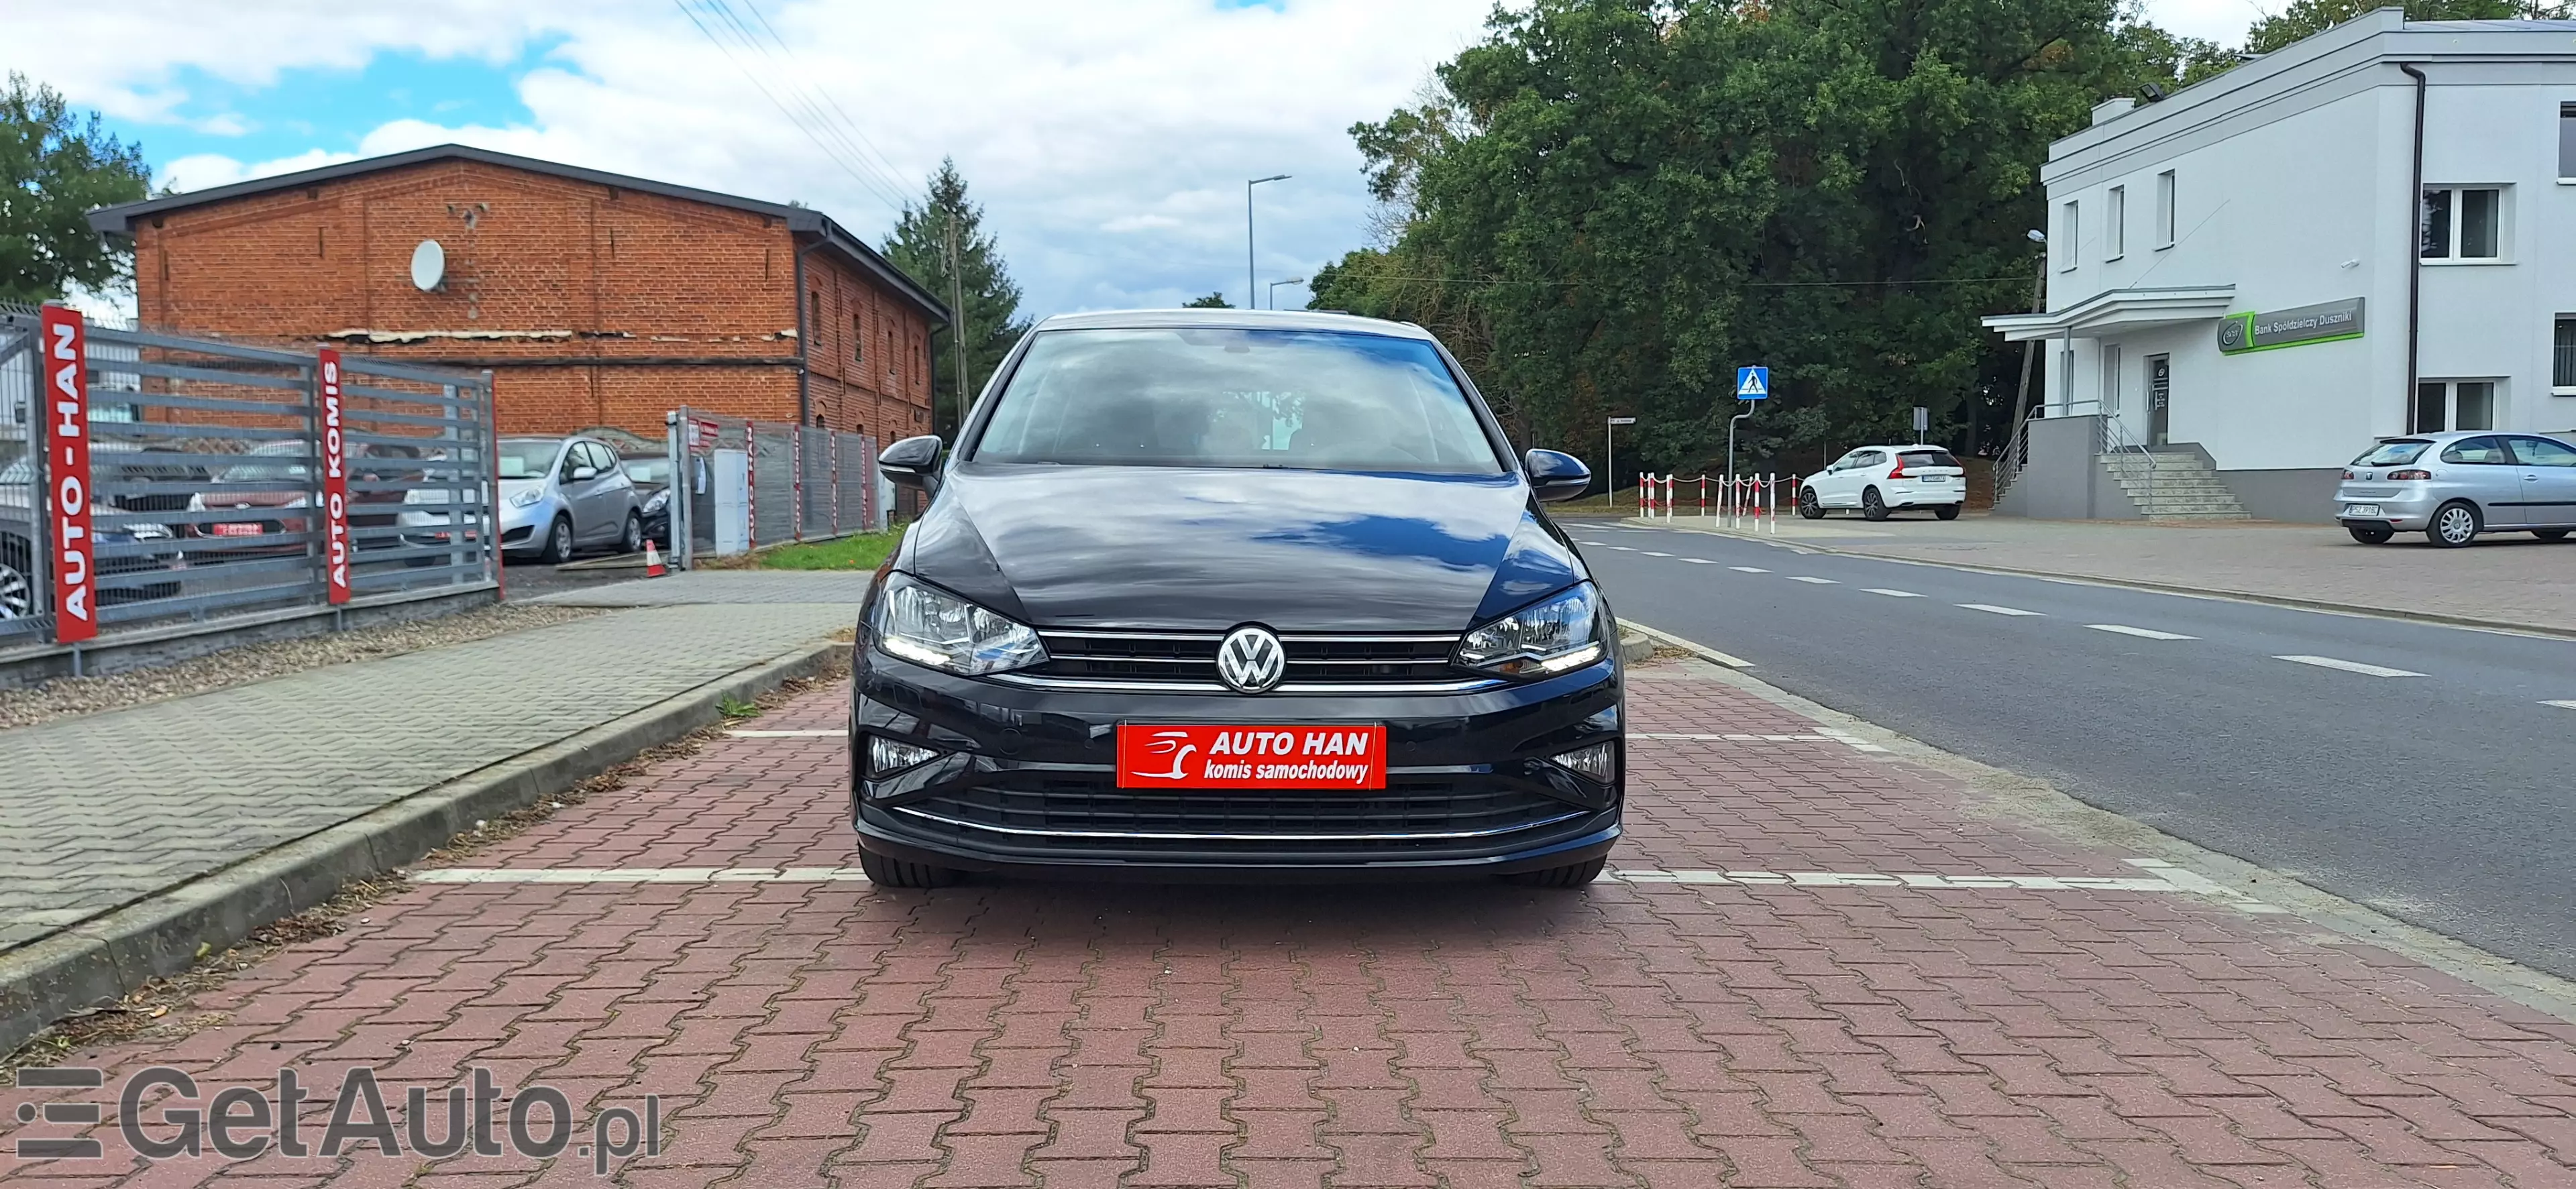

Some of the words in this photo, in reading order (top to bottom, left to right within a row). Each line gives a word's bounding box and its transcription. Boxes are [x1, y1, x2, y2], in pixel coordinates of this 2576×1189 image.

[2255, 324, 2272, 335] Bank
[2273, 318, 2318, 334] Spółdzielczy
[2319, 310, 2353, 325] Duszniki
[52, 323, 80, 437] HAN
[323, 361, 341, 478] KOMIS
[60, 475, 88, 622] AUTO
[329, 492, 347, 588] AUTO
[1203, 759, 1252, 780] komis
[1255, 759, 1369, 785] samochodowy
[1208, 732, 1294, 756] AUTO
[1302, 732, 1369, 756] HAN
